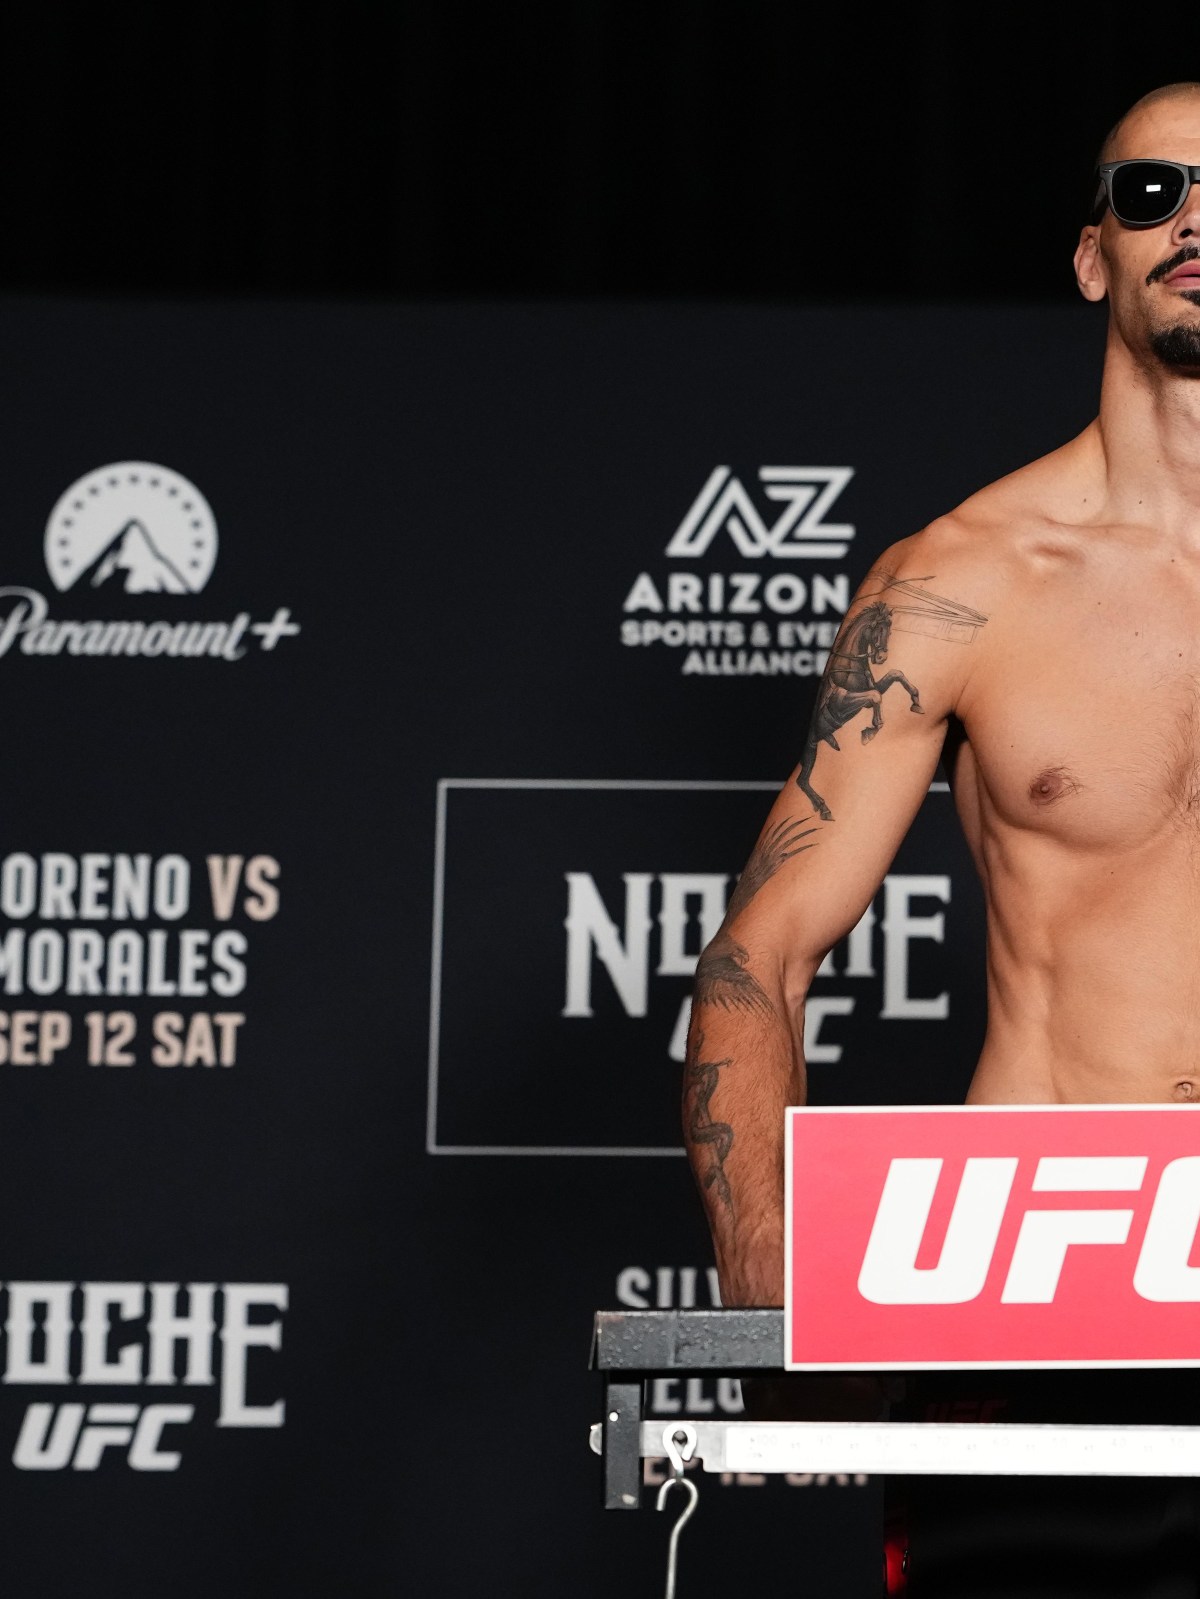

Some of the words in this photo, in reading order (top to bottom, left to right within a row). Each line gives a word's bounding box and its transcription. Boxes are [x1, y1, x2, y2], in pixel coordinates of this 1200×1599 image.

[623, 573, 849, 614] ARIZON
[621, 620, 745, 647] SPORTS
[752, 621, 770, 647] &
[778, 621, 841, 647] EVE
[0, 852, 190, 920] ORENO
[206, 854, 280, 921] VS
[563, 872, 951, 1019] NOE
[0, 1011, 71, 1066] EP
[85, 1011, 136, 1066] 12
[152, 1012, 246, 1067] SAT
[0, 1281, 289, 1427] OCHE
[12, 1403, 194, 1471] UFC
